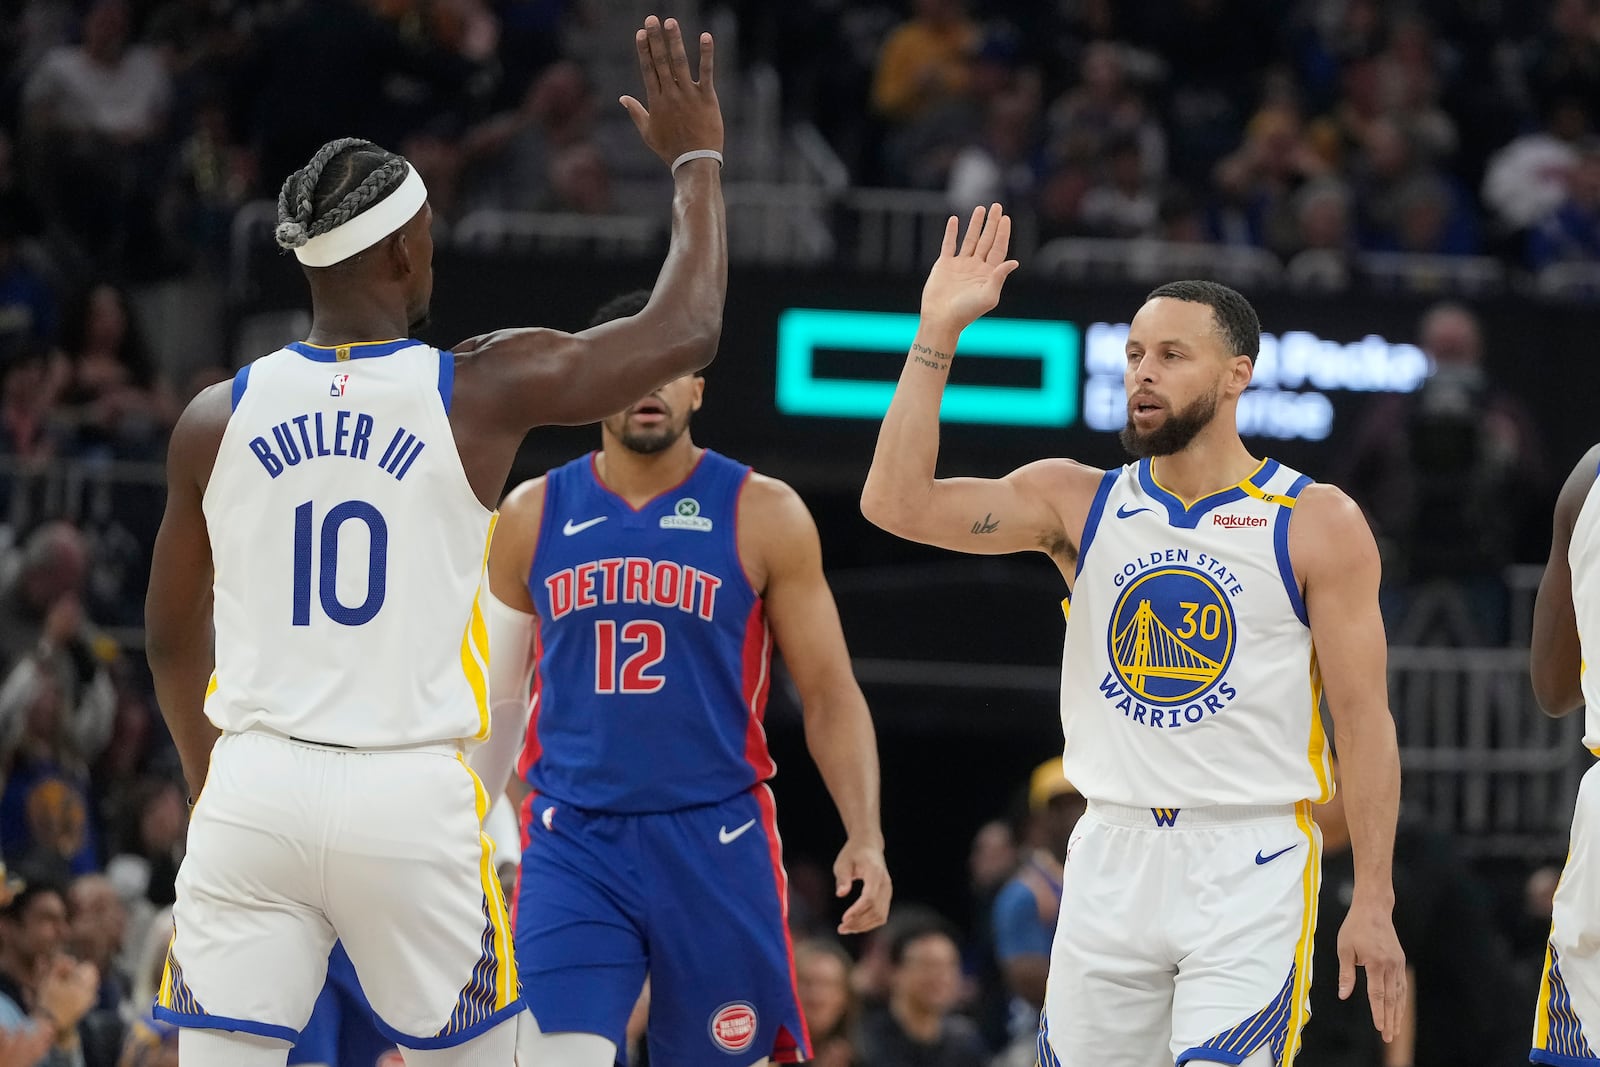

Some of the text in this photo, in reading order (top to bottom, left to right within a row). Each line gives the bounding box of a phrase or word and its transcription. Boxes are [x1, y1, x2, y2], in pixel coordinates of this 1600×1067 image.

[249, 410, 426, 481] BUTLER III
[1213, 514, 1267, 527] Rakuten
[1261, 493, 1275, 502] 16
[292, 499, 388, 626] 10
[545, 557, 722, 622] DETROIT
[1113, 549, 1244, 597] GOLDEN STATE
[1176, 601, 1222, 641] 30
[594, 619, 666, 694] 12
[1099, 672, 1237, 728] WARRIORS
